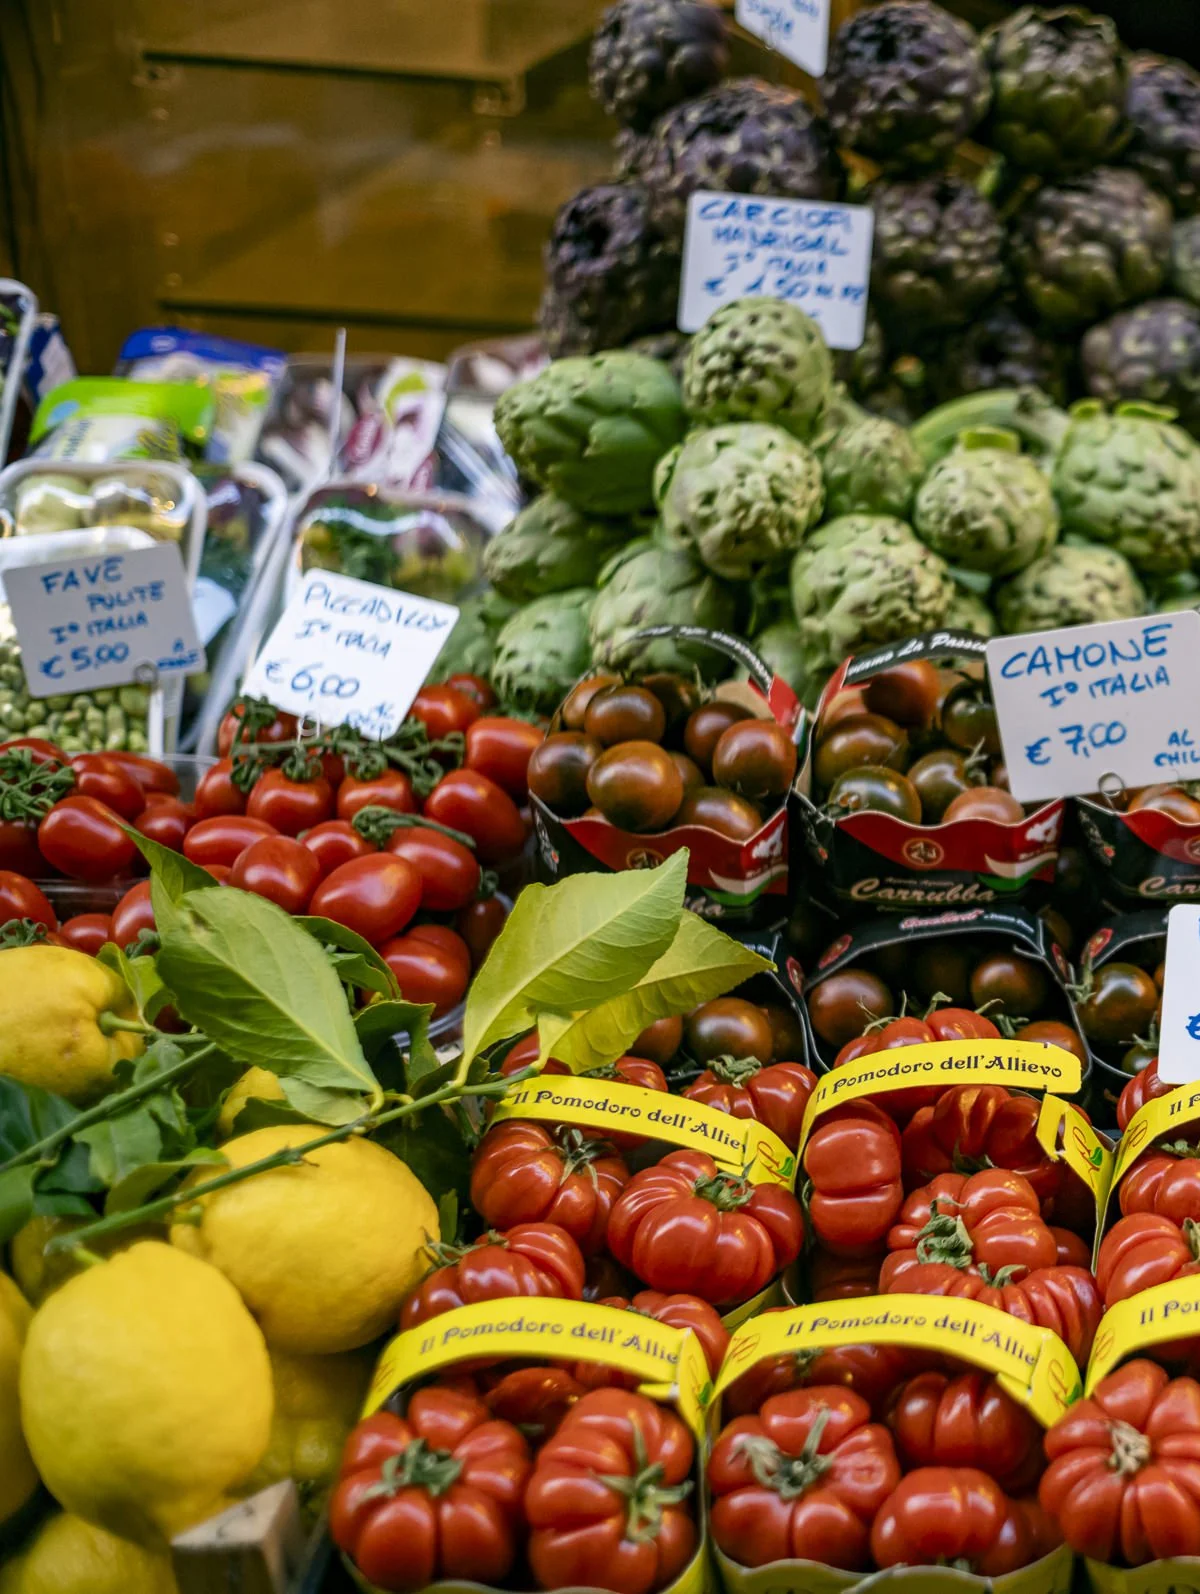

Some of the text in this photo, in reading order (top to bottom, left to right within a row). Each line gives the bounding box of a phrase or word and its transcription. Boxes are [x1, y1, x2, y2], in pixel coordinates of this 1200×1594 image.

[41, 556, 124, 595] FAVE
[86, 580, 165, 613] PULITE
[304, 581, 449, 632] PICCADILLY
[87, 611, 149, 636] ITALIA
[40, 655, 66, 679] €
[70, 641, 130, 672] 5,00
[336, 629, 392, 658] ITALIA
[1001, 623, 1173, 679] CAMONE
[265, 658, 361, 701] € 6,00
[1089, 665, 1170, 698] ITALIA
[1025, 721, 1127, 765] € 7,00
[1168, 729, 1194, 747] AL
[850, 877, 998, 903] Carrubba
[831, 1060, 934, 1095] Pomodoro
[940, 1055, 1062, 1078] dell'Allievo
[512, 1090, 529, 1105] Il
[534, 1090, 641, 1118] Pomodoro
[1169, 1100, 1182, 1116] Il
[1139, 1305, 1154, 1325] Il
[441, 1316, 563, 1345] Pomodoro
[571, 1323, 679, 1364] dell'Allie
[785, 1310, 1036, 1365] Il Pomodoro dell'Allie
